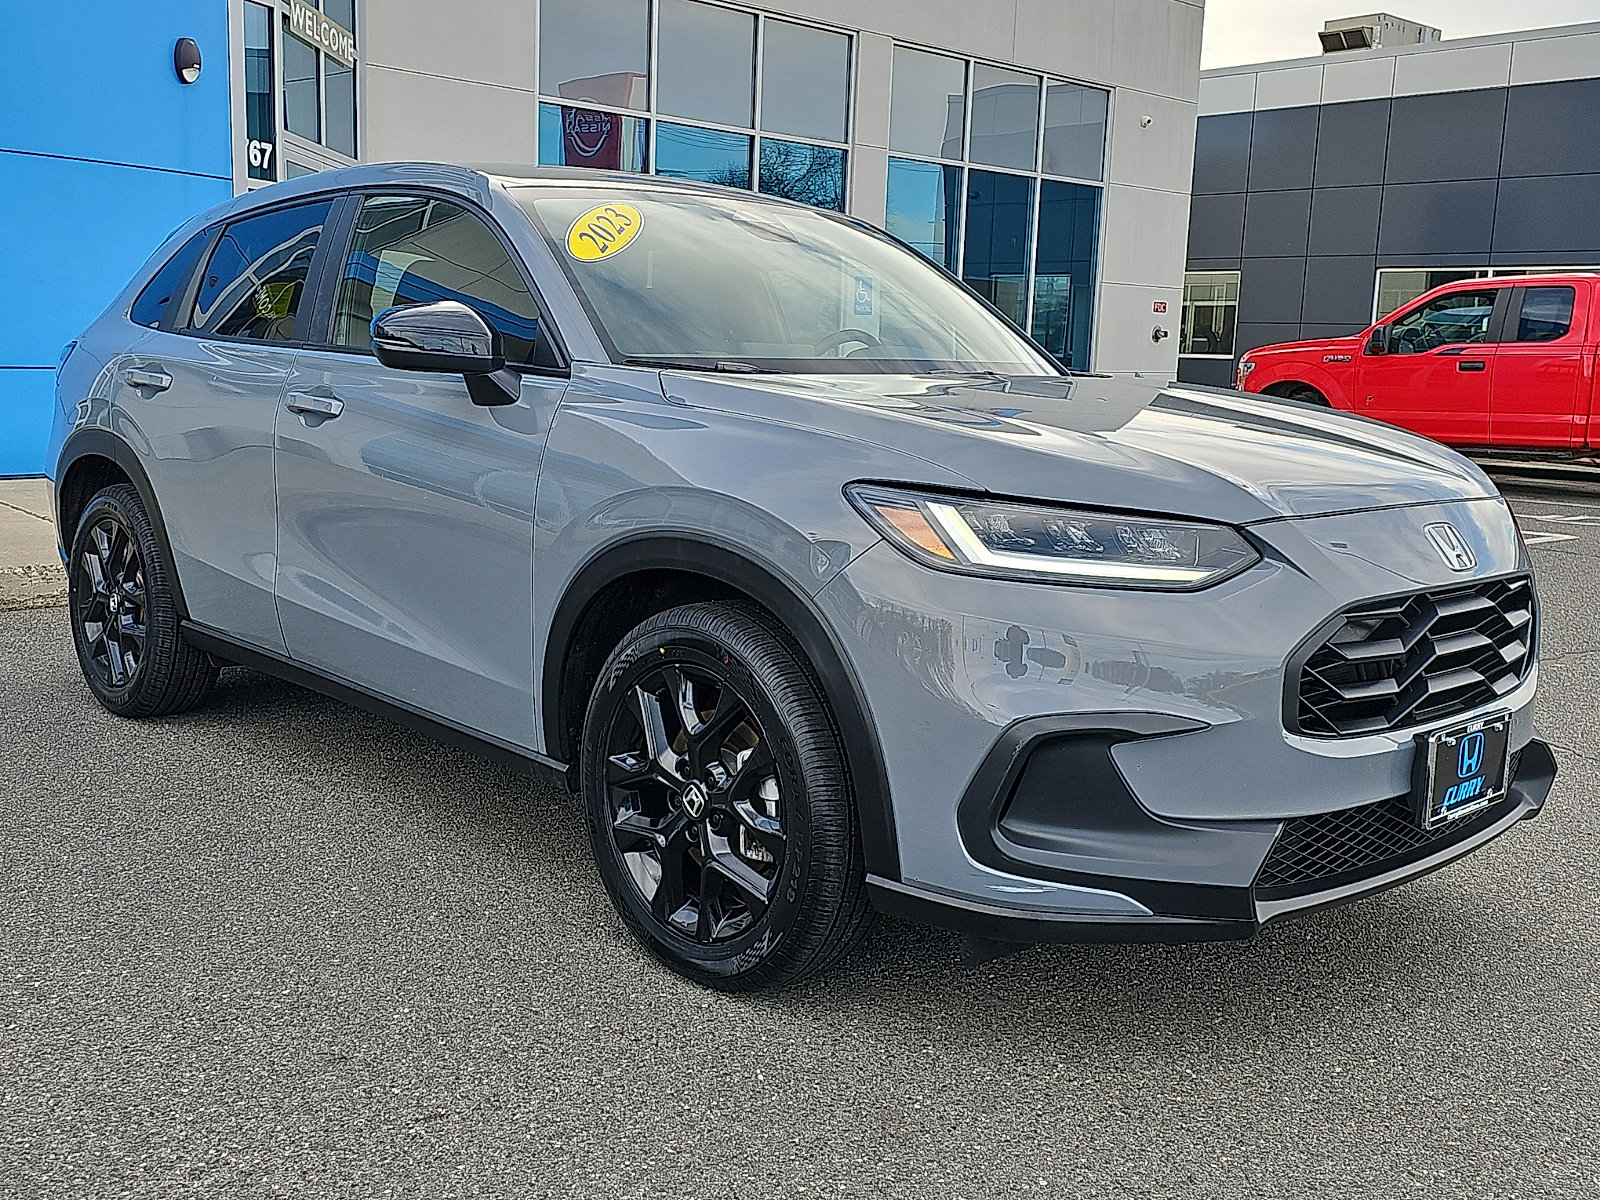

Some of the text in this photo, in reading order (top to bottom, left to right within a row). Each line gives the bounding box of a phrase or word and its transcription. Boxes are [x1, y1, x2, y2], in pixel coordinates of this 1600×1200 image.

[290, 2, 354, 62] WELCOME
[246, 139, 273, 169] 67
[579, 207, 632, 254] 2023
[1154, 303, 1166, 312] FDC
[1444, 775, 1486, 806] CURRY
